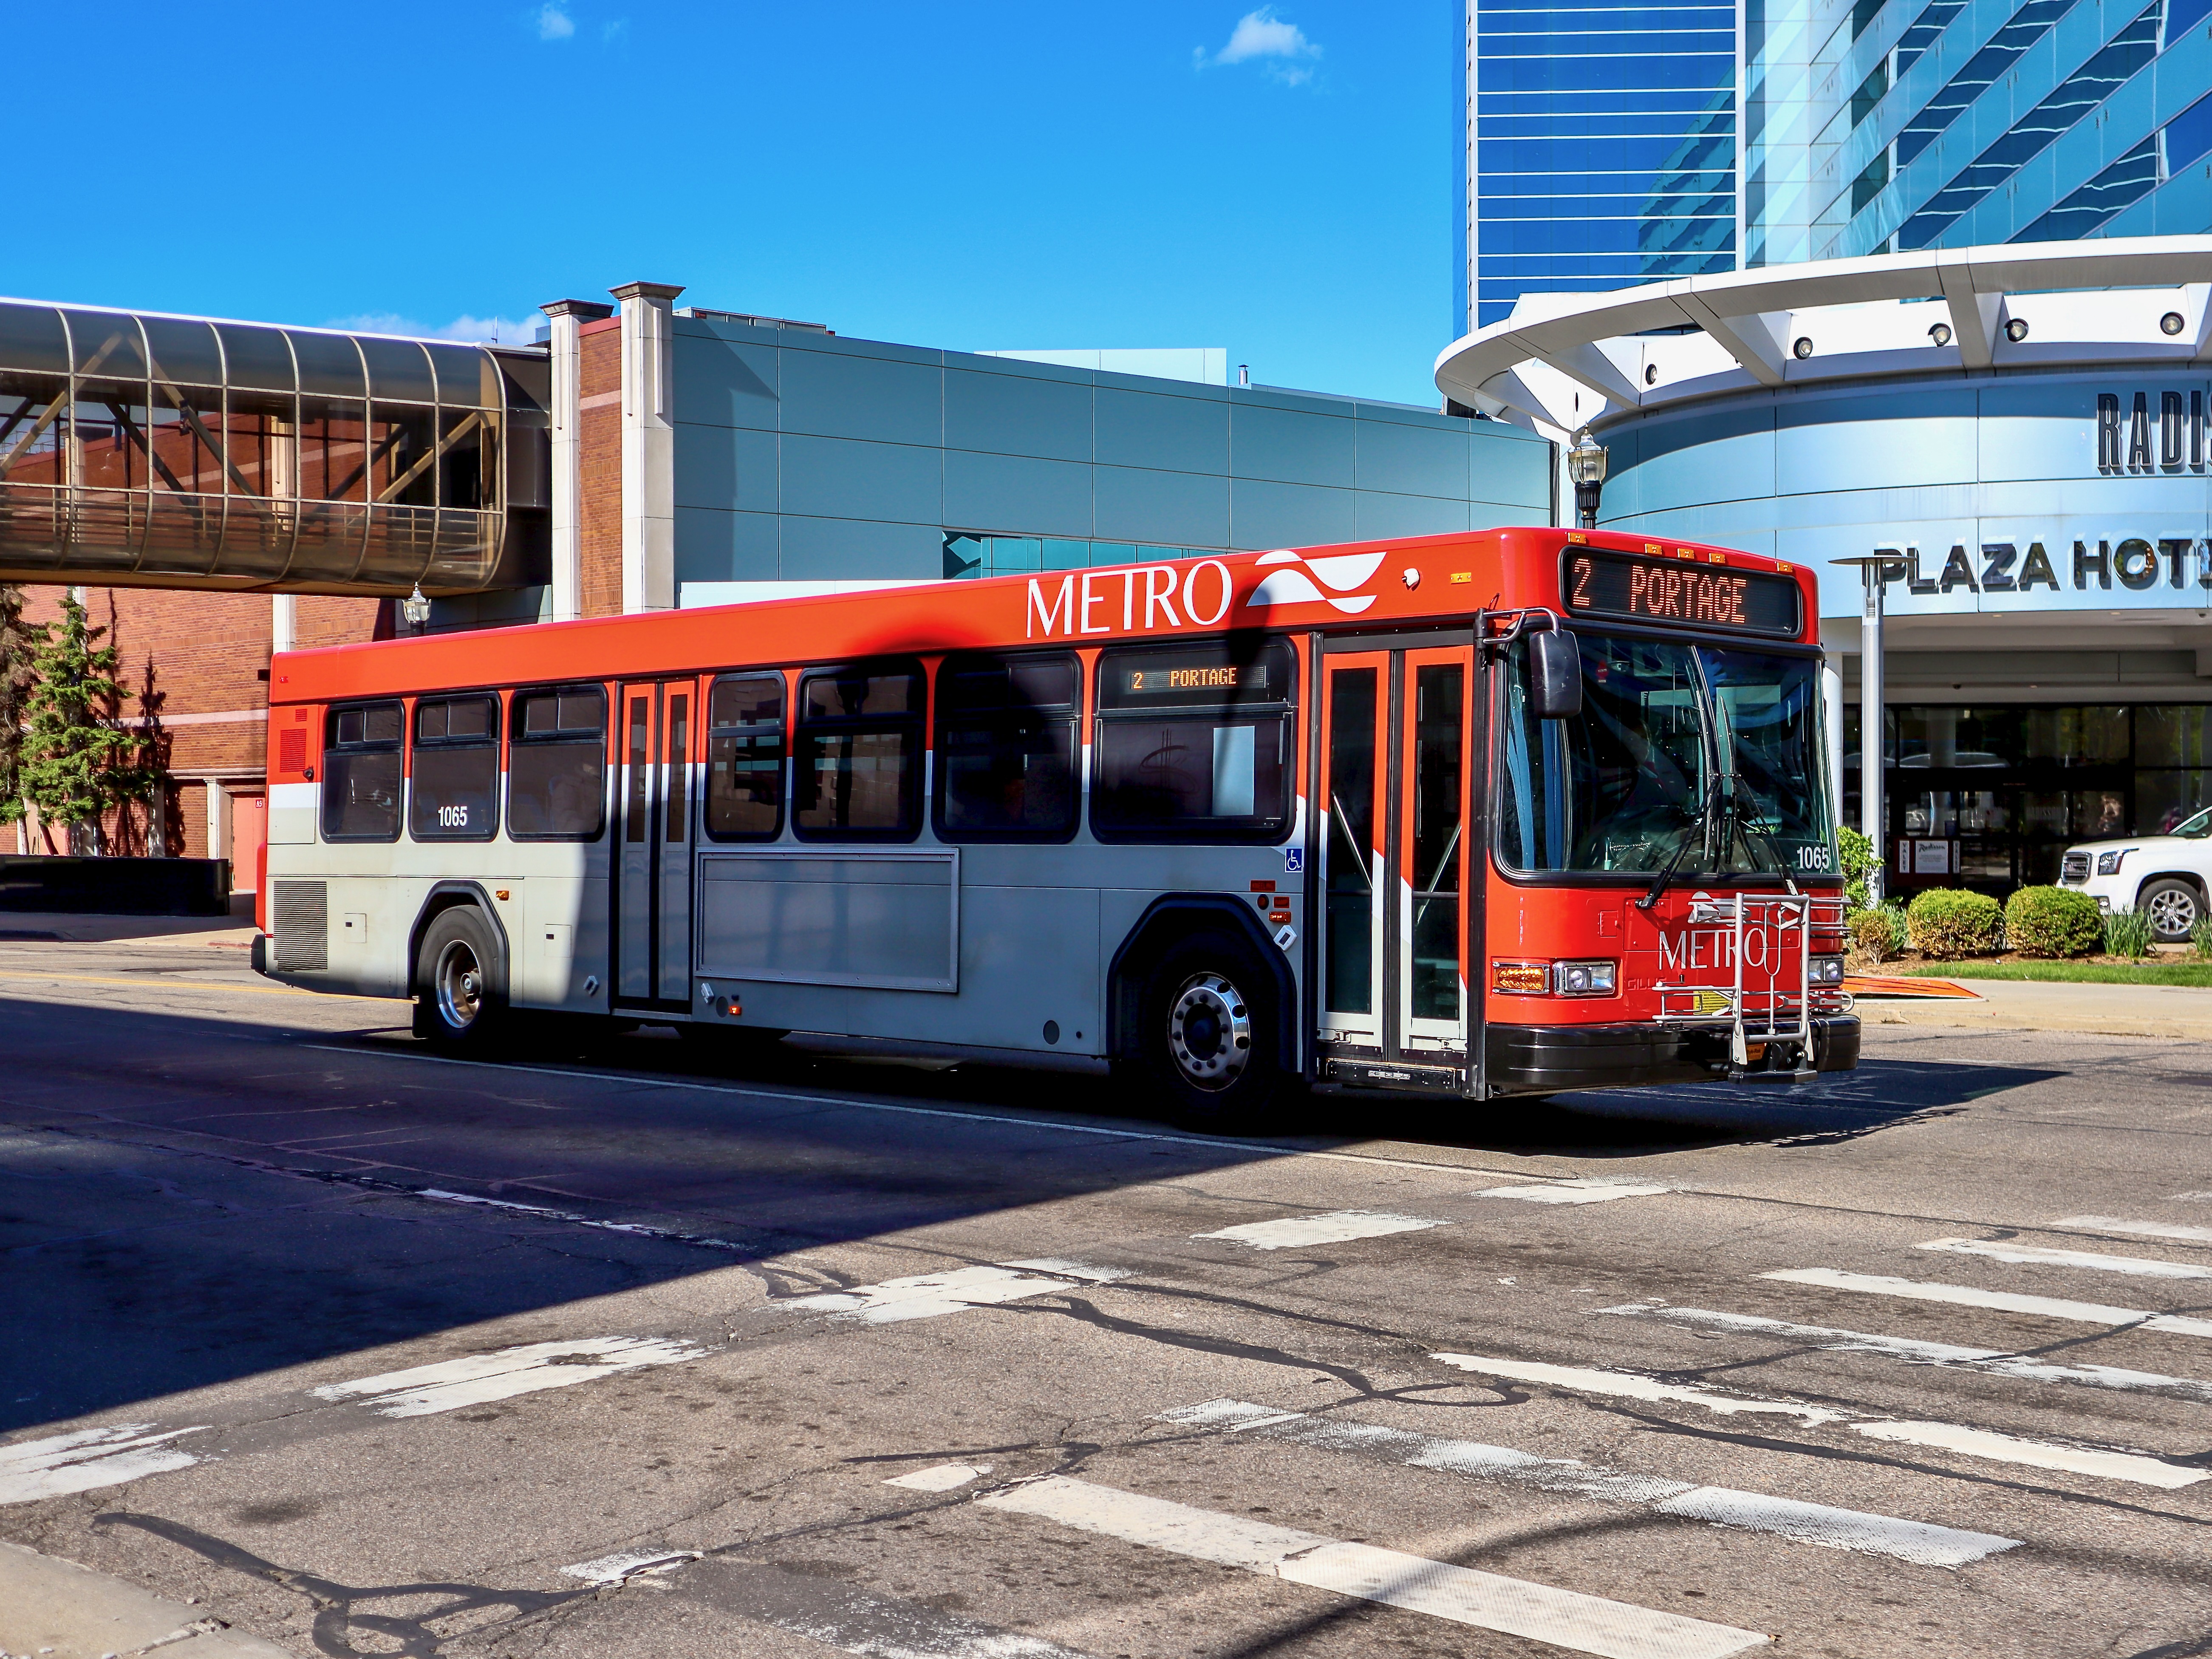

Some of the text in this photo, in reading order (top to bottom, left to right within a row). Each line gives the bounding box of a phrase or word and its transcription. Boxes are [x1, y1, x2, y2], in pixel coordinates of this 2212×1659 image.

[2097, 391, 2212, 468] RADI
[1027, 560, 1233, 638] METRO
[1573, 558, 1747, 623] 2 PORTAGE
[1133, 668, 1237, 689] 2 PORTAGE
[438, 806, 467, 827] 1065
[1796, 846, 1830, 869] 1065
